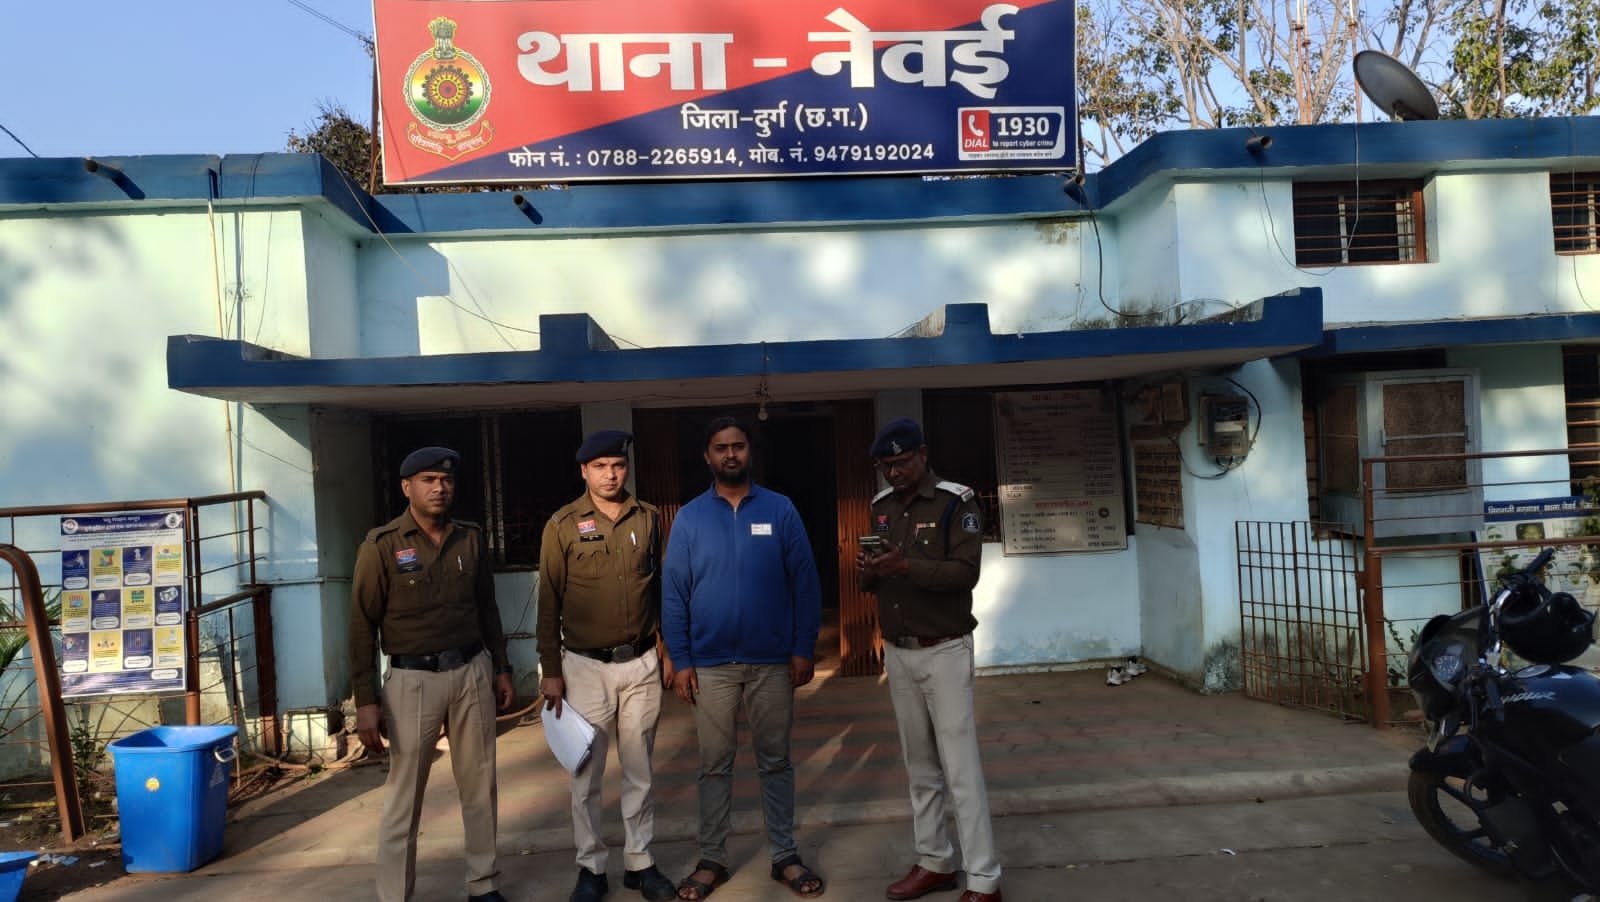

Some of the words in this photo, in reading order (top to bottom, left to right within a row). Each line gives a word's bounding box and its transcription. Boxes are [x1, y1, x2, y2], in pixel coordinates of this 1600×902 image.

[517, 31, 733, 91] थाना
[807, 4, 1019, 99] नेवई
[681, 101, 788, 138] जिला-दुर्ग
[794, 102, 869, 132] (छ.ग.)
[996, 116, 1050, 137] 1930
[508, 146, 547, 168] फोन
[550, 144, 570, 166] नं.
[588, 147, 744, 167] 0788-2265914,
[748, 144, 784, 163] मोब.
[789, 142, 809, 162] नं.
[815, 144, 935, 162] 9479192024
[964, 139, 989, 149] DIAL
[1000, 140, 1018, 148] report
[1019, 140, 1036, 148] cyber
